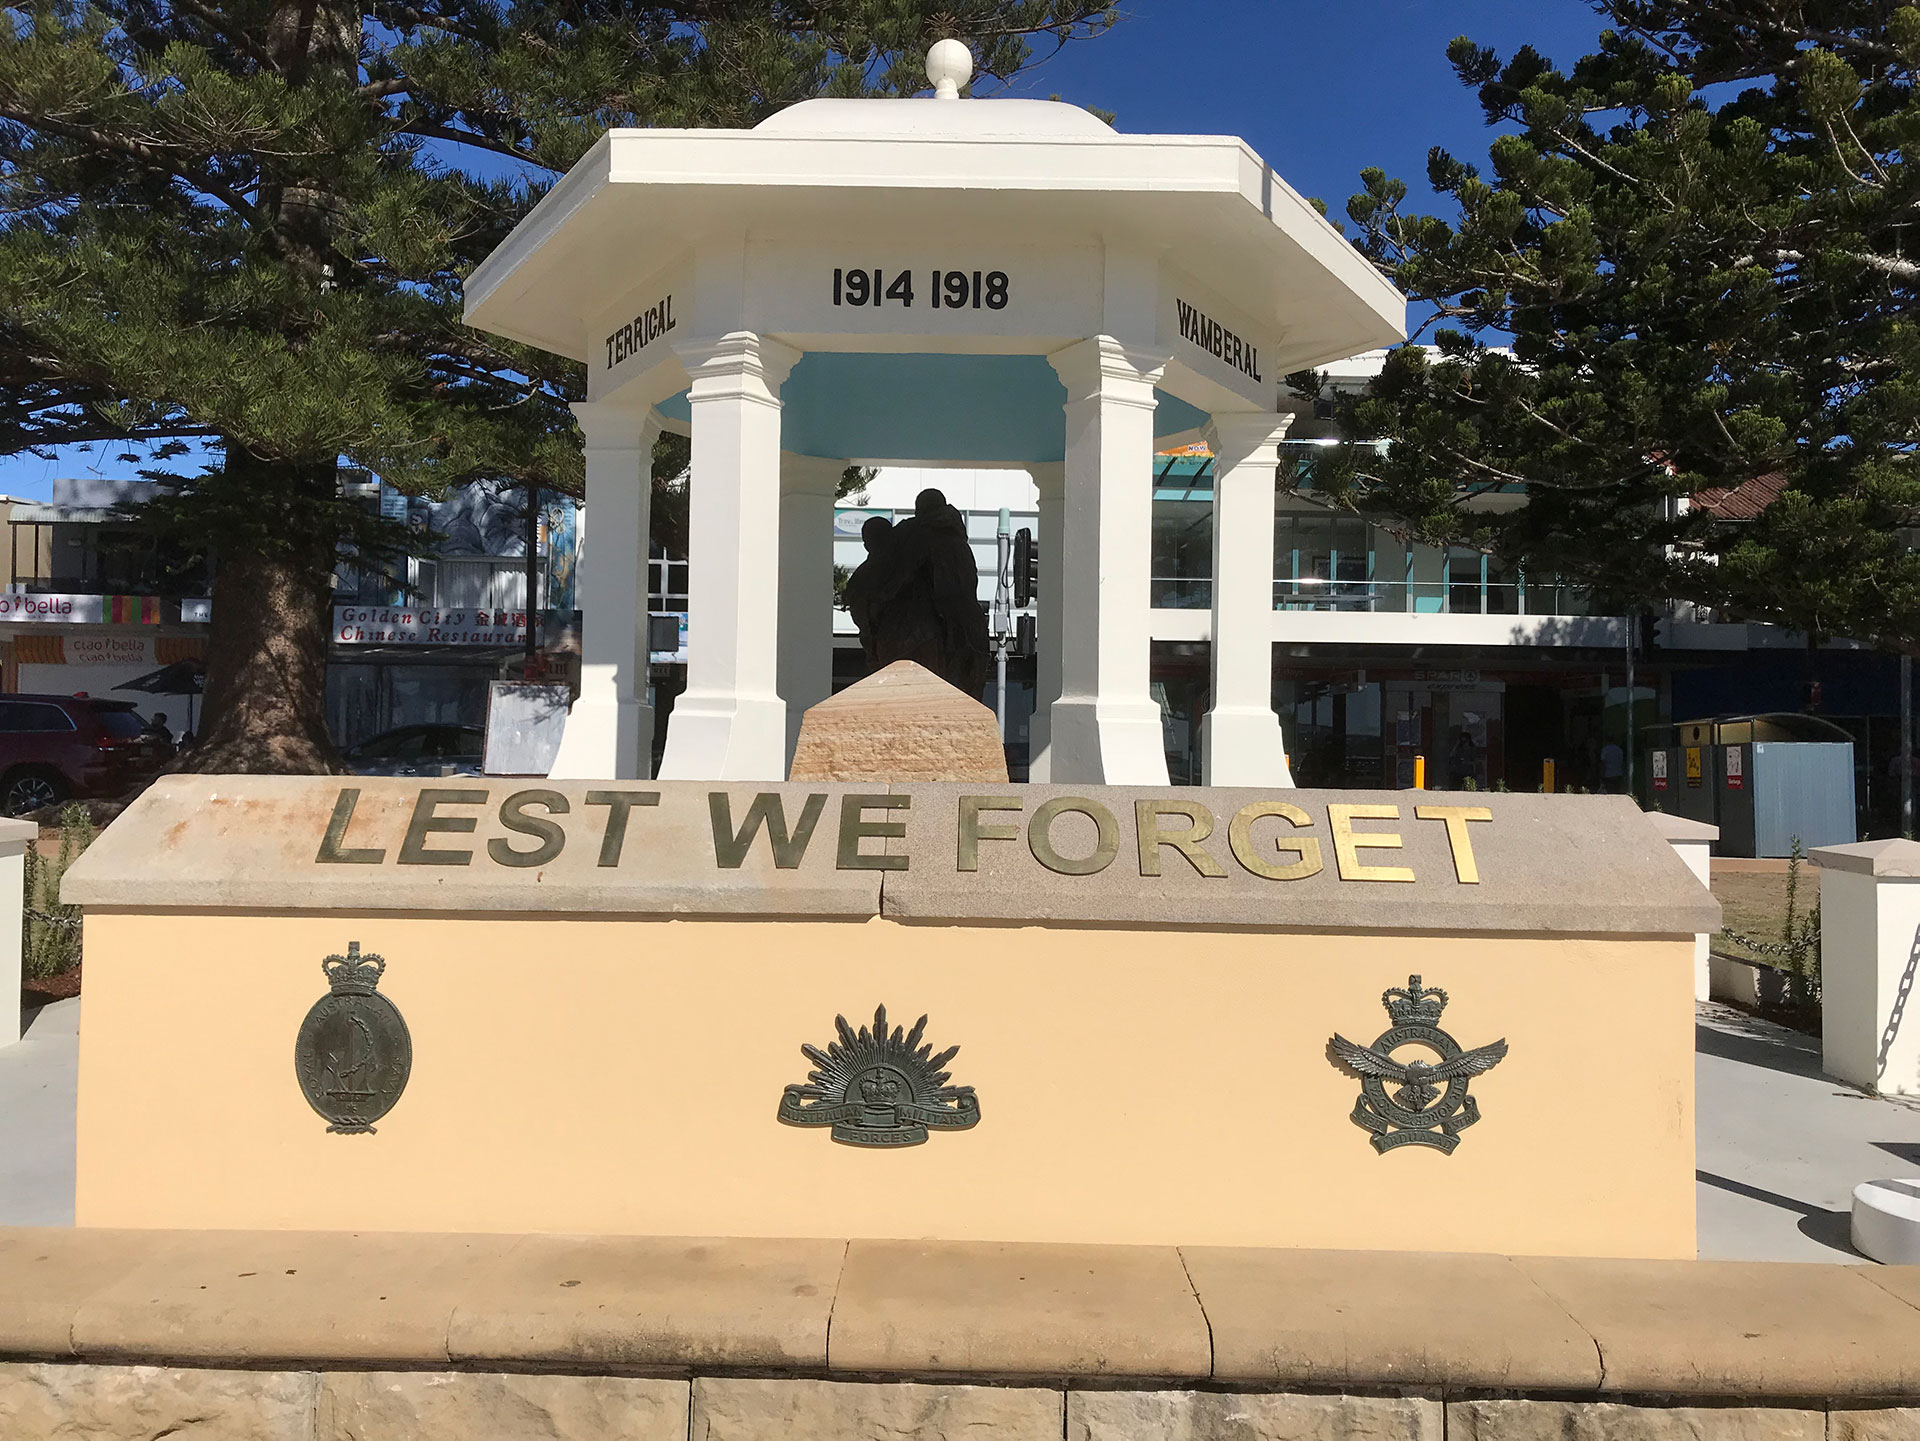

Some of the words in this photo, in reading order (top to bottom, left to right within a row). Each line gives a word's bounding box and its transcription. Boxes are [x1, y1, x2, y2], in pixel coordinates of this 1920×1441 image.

[833, 268, 914, 308] 1914
[931, 270, 1009, 310] 1918
[1175, 298, 1262, 383] WAMBERAL
[25, 597, 72, 614] bella
[342, 608, 412, 624] Golden
[419, 611, 465, 626] City
[341, 625, 416, 641] Chinese
[427, 628, 527, 643] Restauran
[73, 639, 102, 651] ciao
[112, 638, 144, 651] bella
[1414, 670, 1462, 681] SPAR
[315, 788, 661, 868] LEST
[707, 792, 911, 871] WE
[956, 795, 1493, 885] FORGET
[1380, 1027, 1456, 1055] AUSTRALIAN
[1452, 1078, 1467, 1101] AIR
[782, 1106, 864, 1123] AUSTRALIAN
[898, 1107, 970, 1126] MILITARY
[849, 1132, 912, 1144] FORCES
[1381, 1133, 1428, 1151] ARDUA
